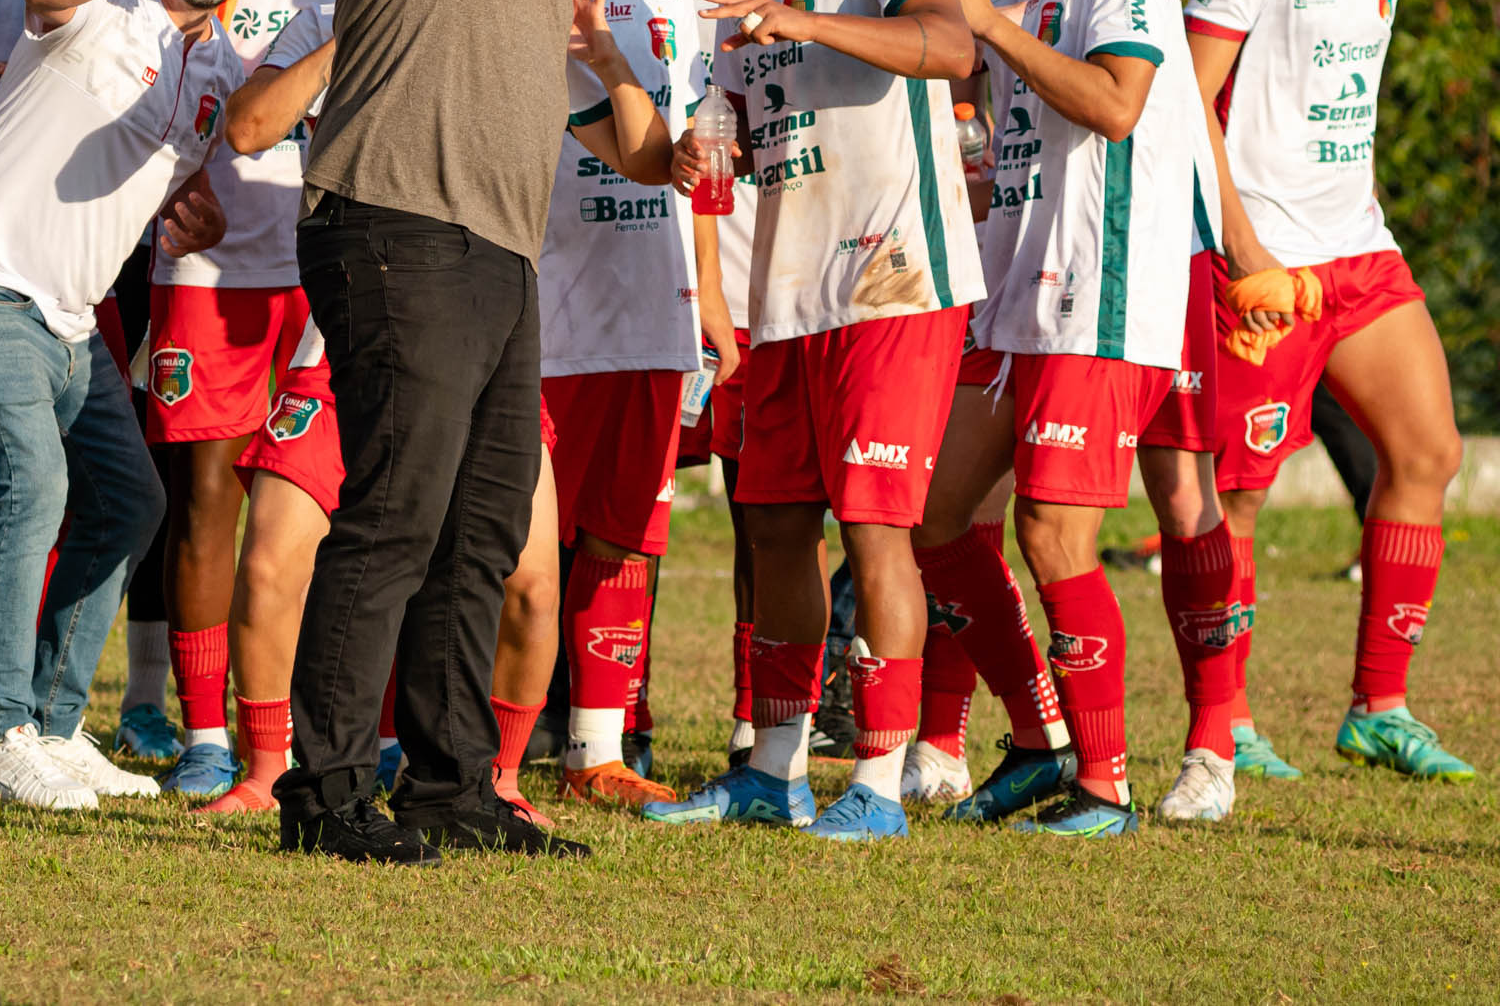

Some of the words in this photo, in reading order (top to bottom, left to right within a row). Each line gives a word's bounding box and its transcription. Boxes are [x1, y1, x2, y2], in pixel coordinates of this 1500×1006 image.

[273, 144, 296, 152] erro
[615, 223, 638, 232] Ferro
[646, 221, 659, 230] Aço
[157, 357, 186, 368] UNIÃO
[284, 396, 313, 411] UNIÃO
[1040, 421, 1088, 445] JMX
[863, 441, 910, 464] JMX
